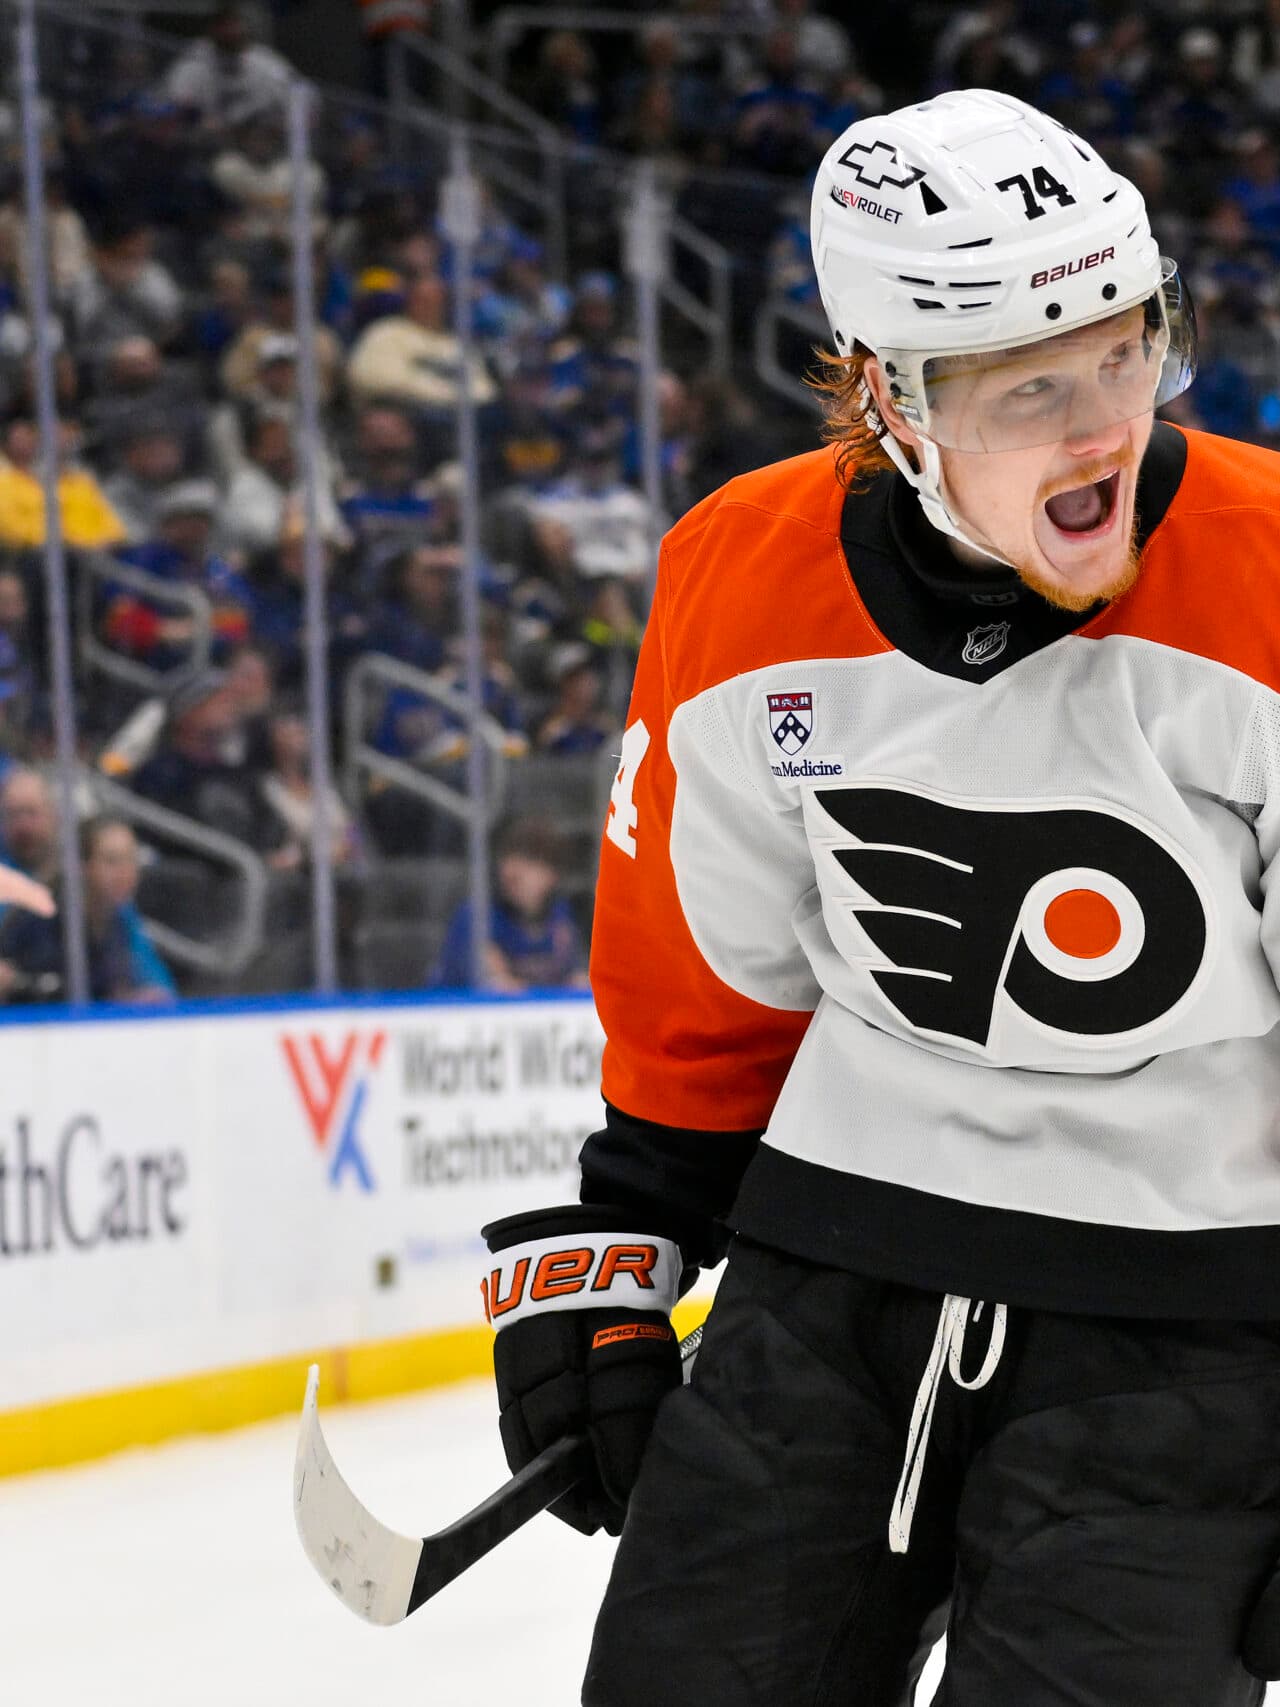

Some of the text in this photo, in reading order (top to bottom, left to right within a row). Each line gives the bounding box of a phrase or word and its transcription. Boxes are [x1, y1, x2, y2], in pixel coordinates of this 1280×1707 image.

[995, 166, 1076, 221] 74
[781, 759, 842, 777] Medicine
[516, 1020, 602, 1088] Wid
[480, 1244, 659, 1323] UER
